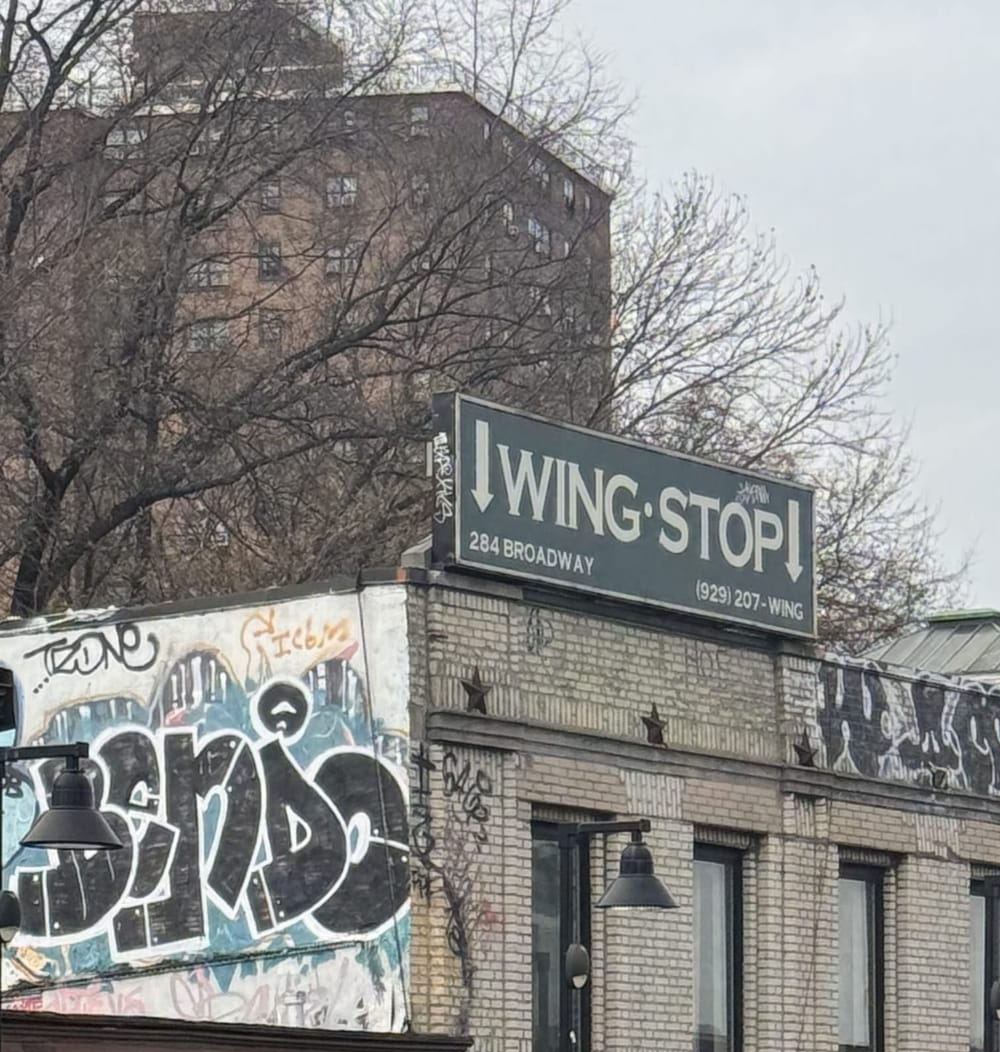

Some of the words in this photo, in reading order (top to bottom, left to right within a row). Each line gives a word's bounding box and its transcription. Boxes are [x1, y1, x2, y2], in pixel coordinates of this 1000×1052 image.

[469, 530, 500, 556] 284
[503, 538, 595, 575] BROADWAY
[696, 580, 732, 605] (929)
[734, 589, 804, 620] 207-WING
